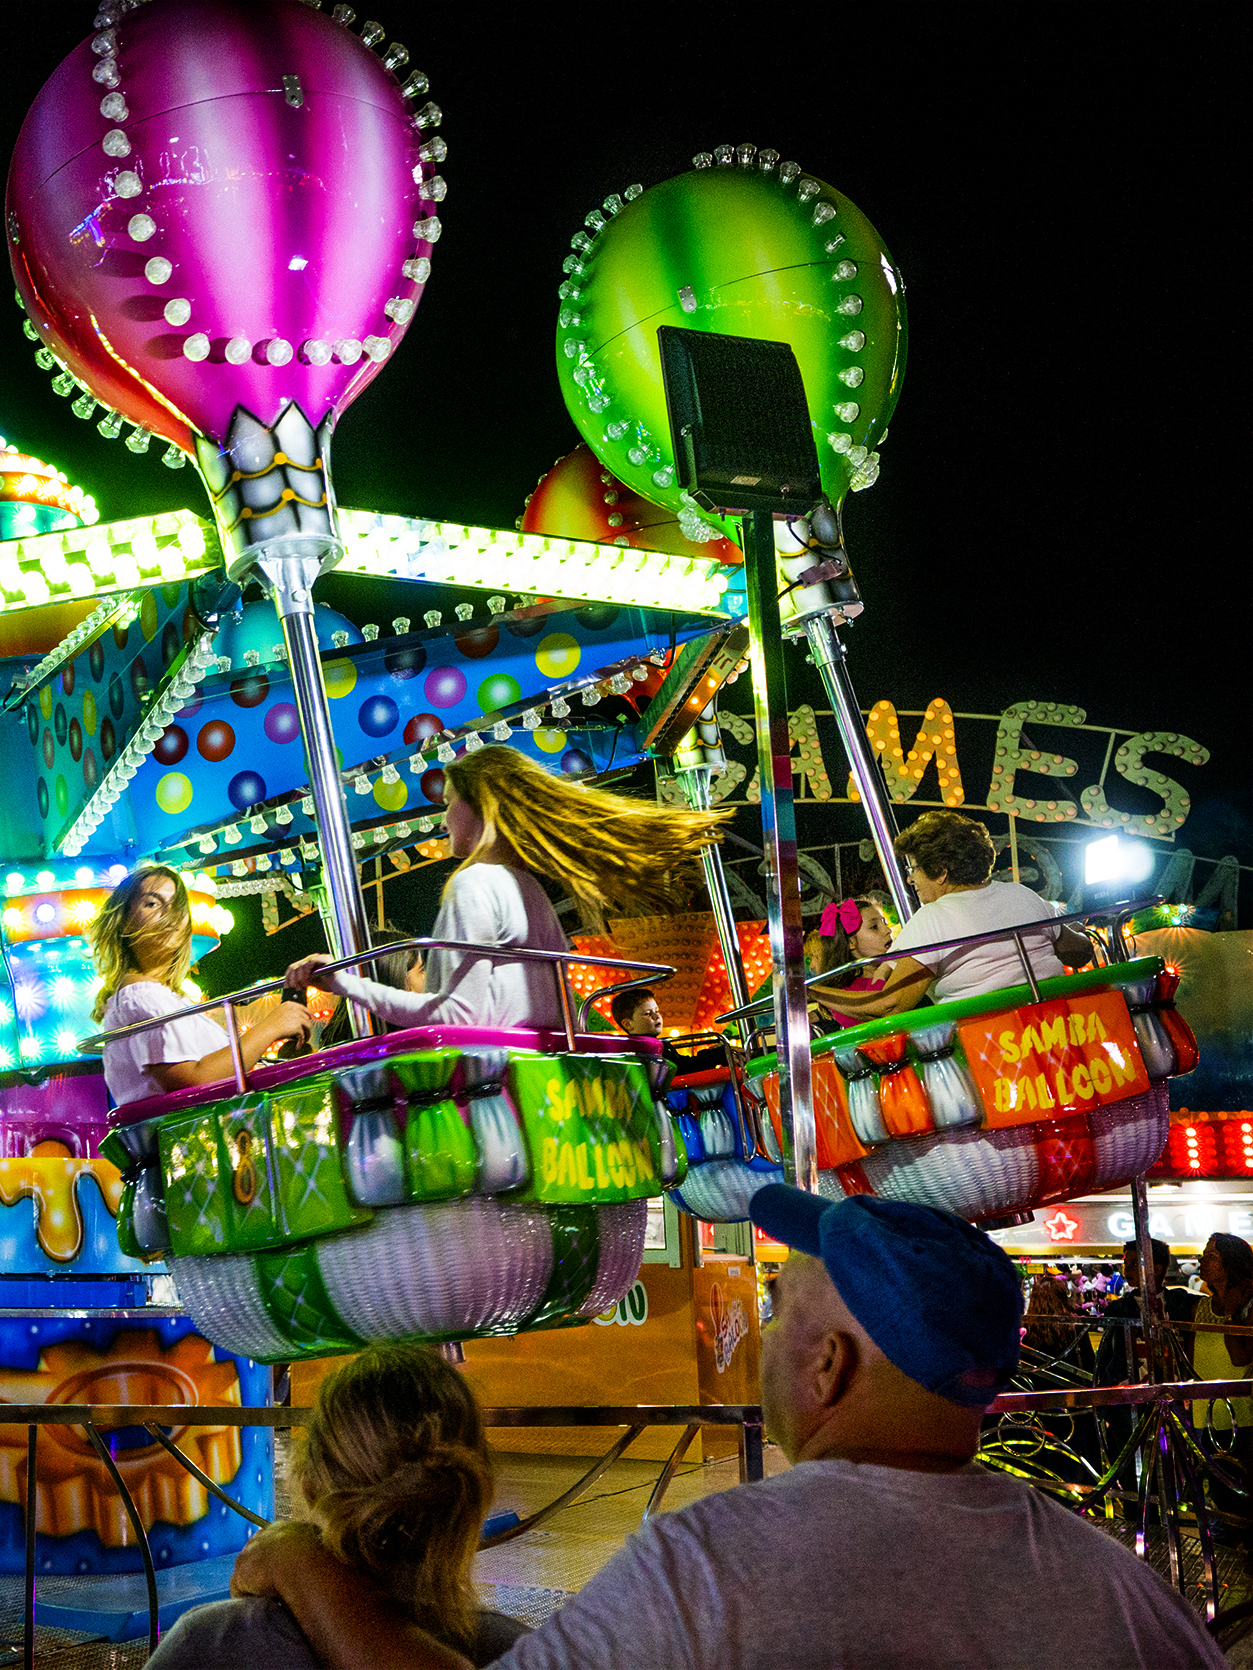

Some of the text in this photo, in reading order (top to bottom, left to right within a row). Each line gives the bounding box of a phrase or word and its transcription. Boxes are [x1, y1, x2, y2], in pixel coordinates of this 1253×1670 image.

[999, 1011, 1107, 1063] SAMBA
[547, 1076, 632, 1121] SAMBA
[993, 1048, 1137, 1113] BALLOON
[542, 1136, 654, 1190] BALLOON
